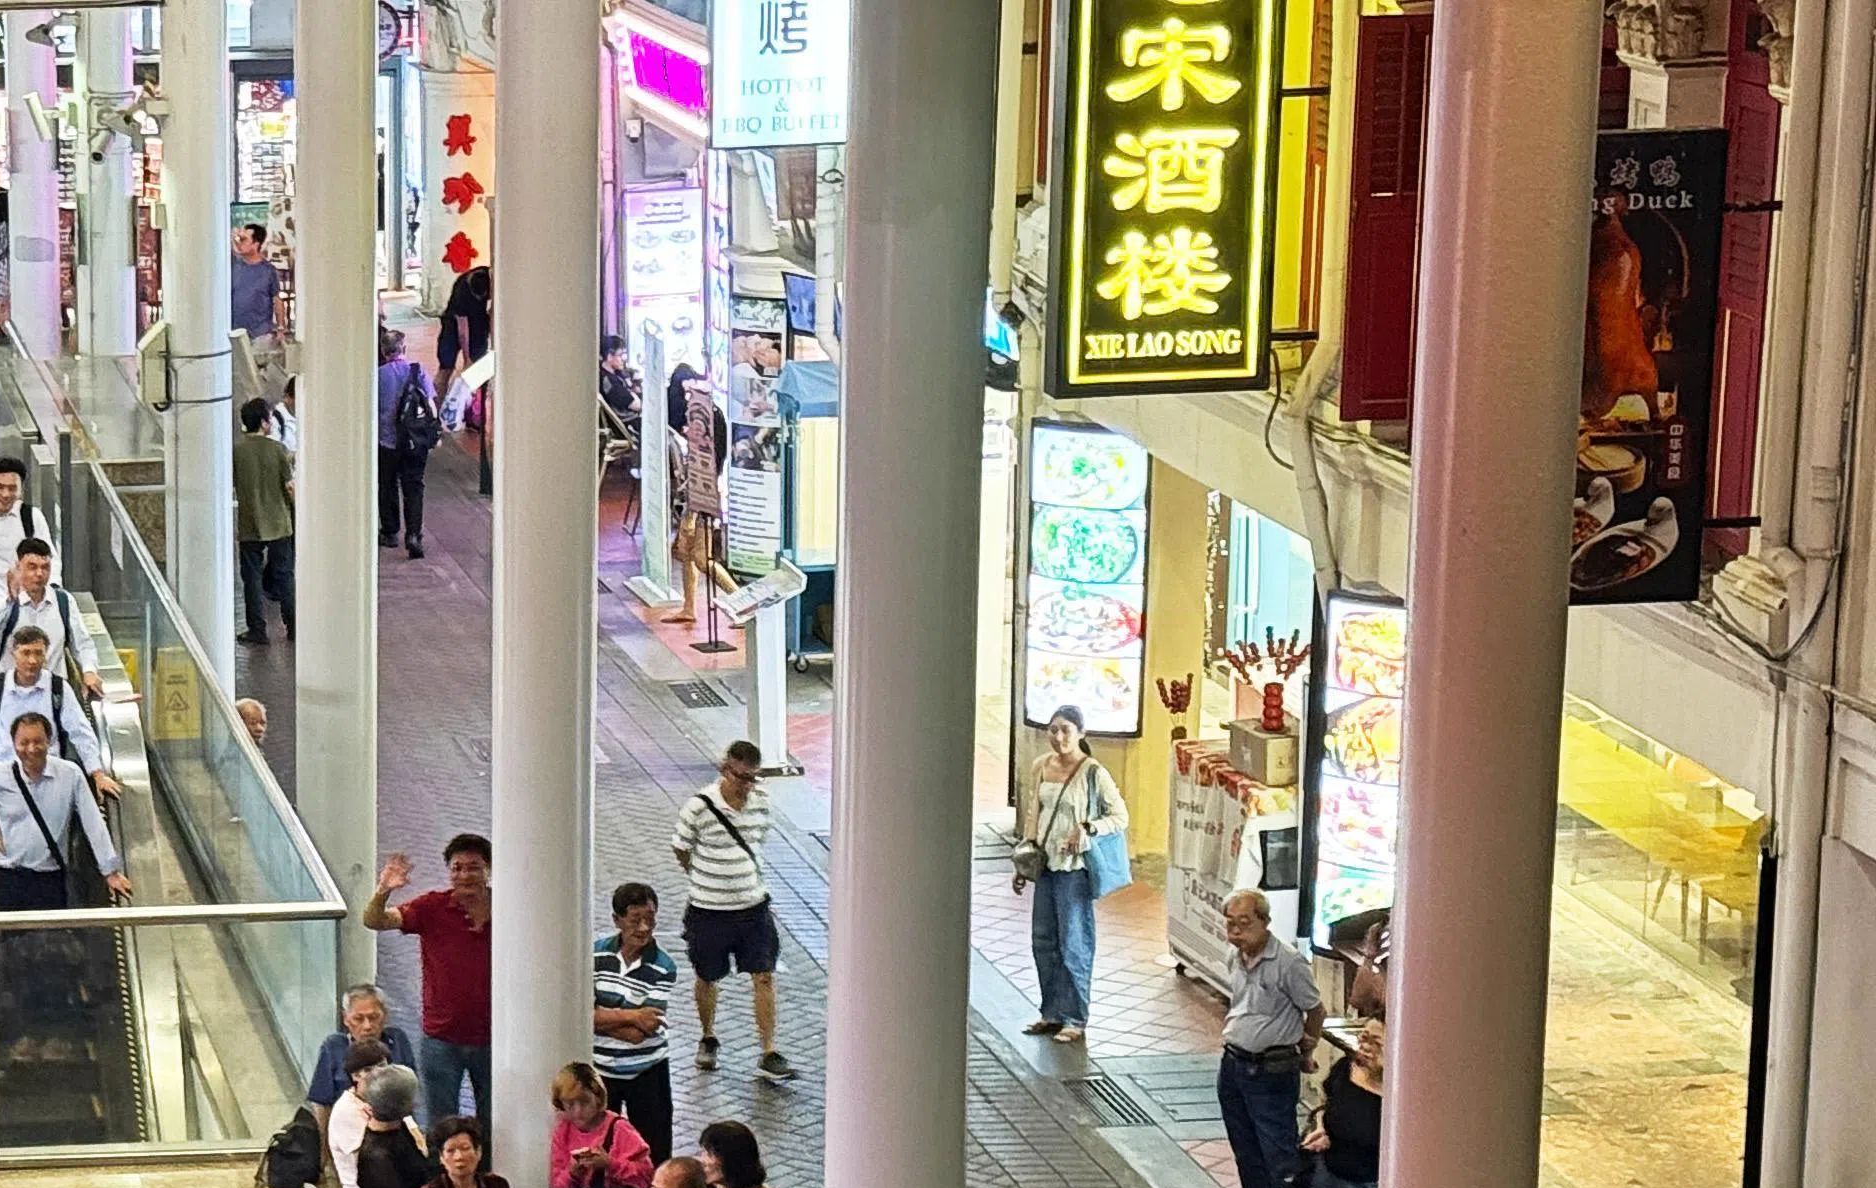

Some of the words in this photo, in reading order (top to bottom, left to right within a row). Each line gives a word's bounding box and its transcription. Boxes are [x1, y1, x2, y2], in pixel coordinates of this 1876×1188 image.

[759, 0, 809, 55] 烤
[774, 97, 789, 112] &
[1096, 0, 1242, 321] 宋酒楼
[1628, 190, 1694, 211] Duck
[1084, 333, 1125, 359] XIE
[1125, 331, 1174, 358] LAO
[1174, 329, 1242, 356] SONG
